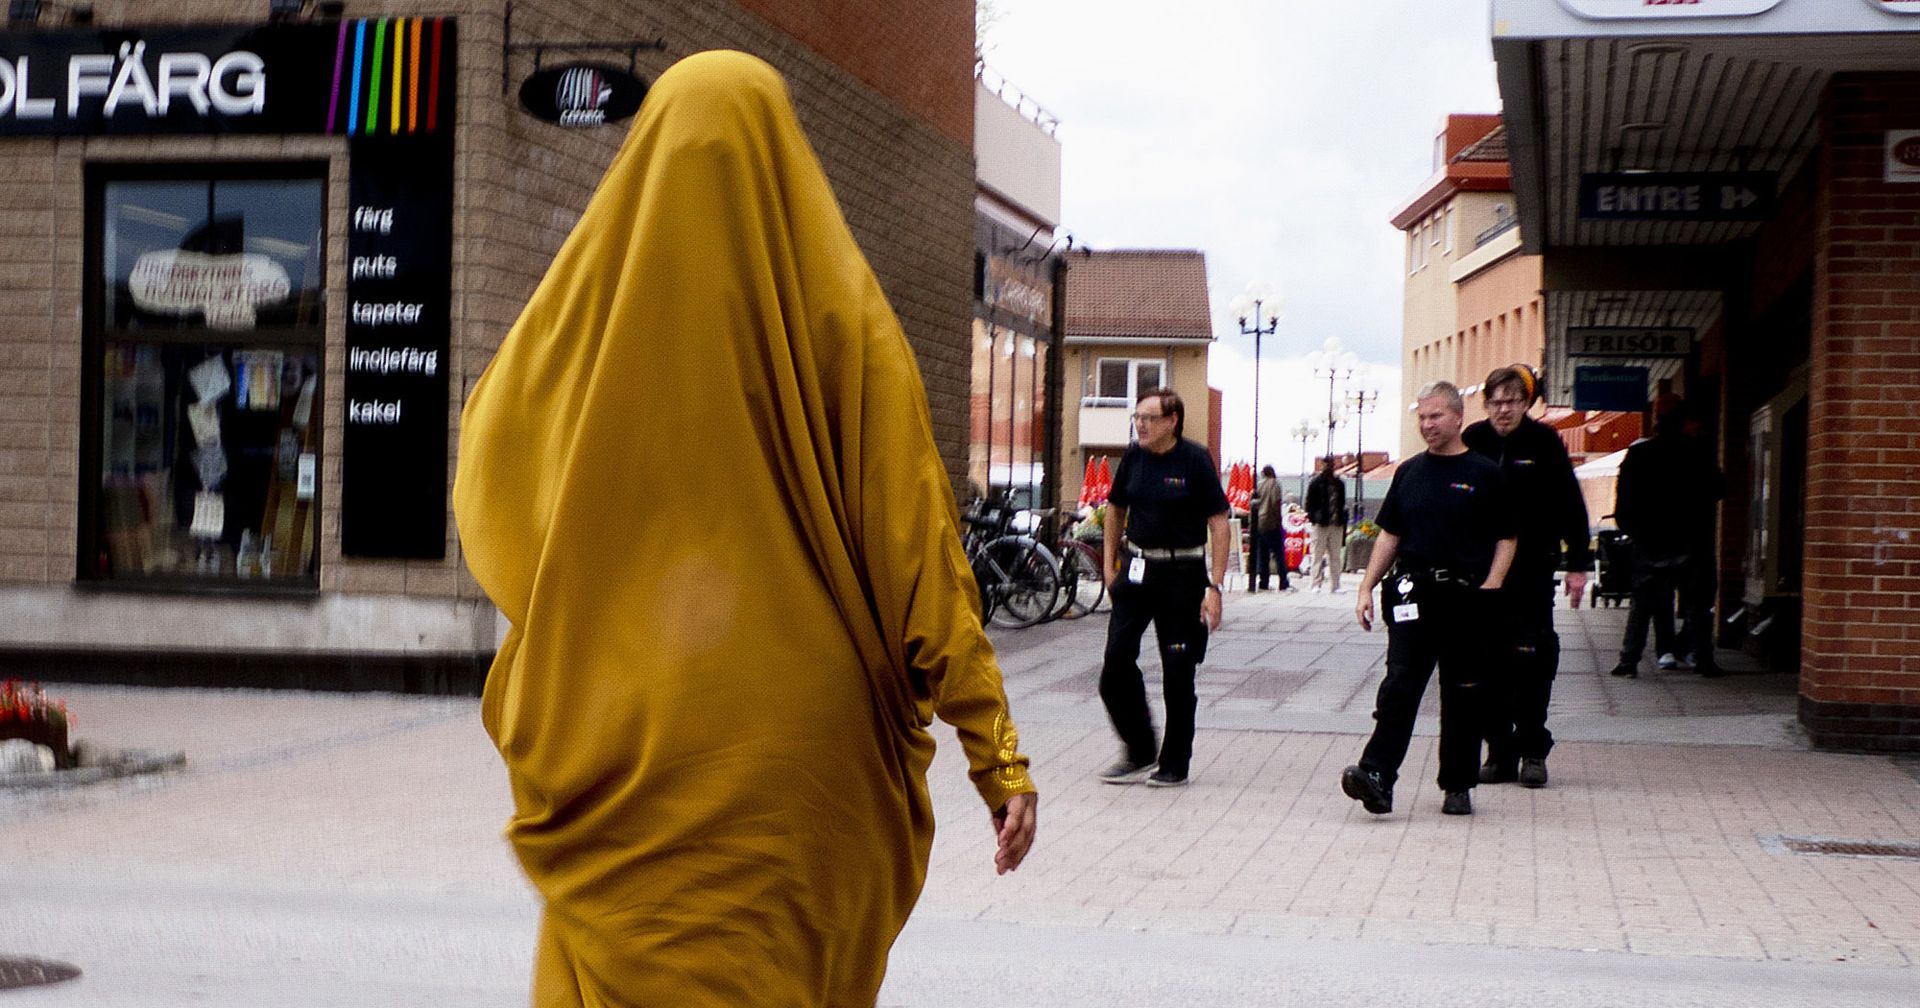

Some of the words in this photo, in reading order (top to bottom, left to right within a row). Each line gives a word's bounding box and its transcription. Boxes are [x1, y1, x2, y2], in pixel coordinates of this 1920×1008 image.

[67, 39, 267, 118] FÄRG
[1597, 185, 1701, 211] ENTRE
[354, 206, 394, 235] färg
[352, 253, 397, 281] puts
[352, 300, 423, 328] tapeter
[1583, 332, 1678, 352] FRISÖR
[350, 346, 437, 377] linoljefärg
[348, 399, 401, 424] kakel
